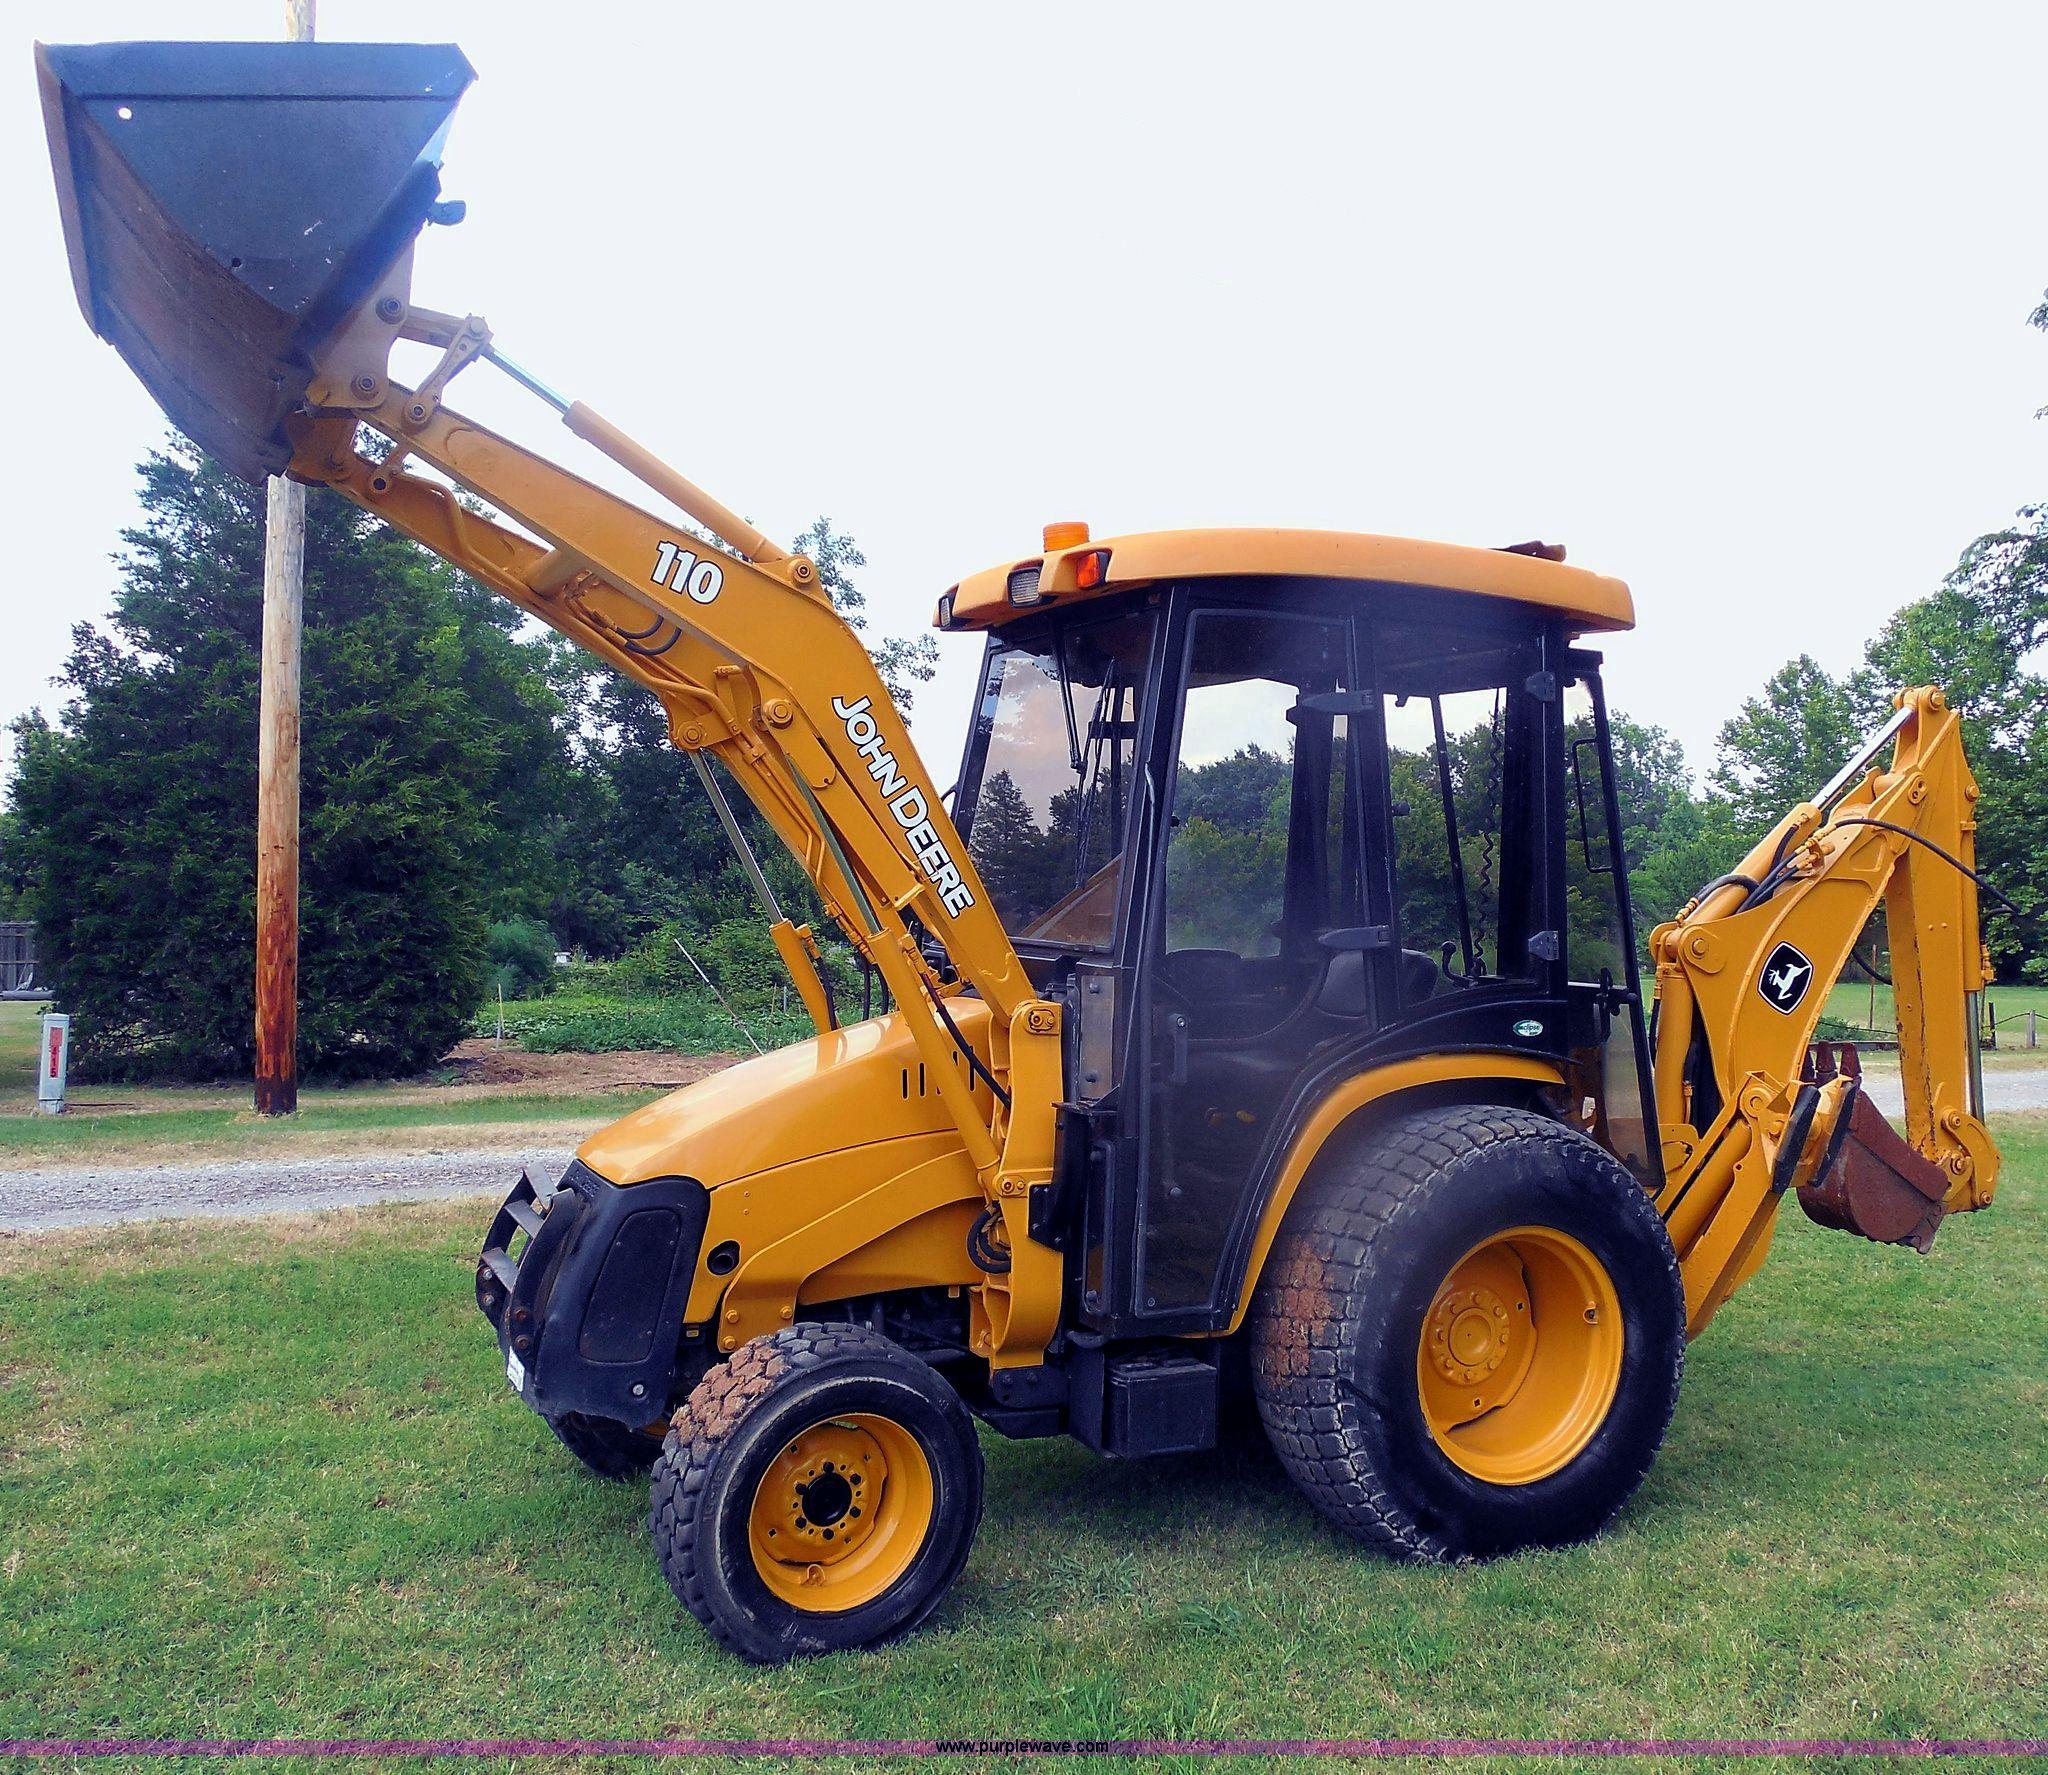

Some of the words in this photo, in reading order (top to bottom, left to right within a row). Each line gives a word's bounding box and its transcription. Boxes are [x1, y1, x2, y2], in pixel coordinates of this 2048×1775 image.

[651, 540, 724, 604] 110
[832, 695, 908, 798] JOHN
[888, 784, 976, 920] DEERE
